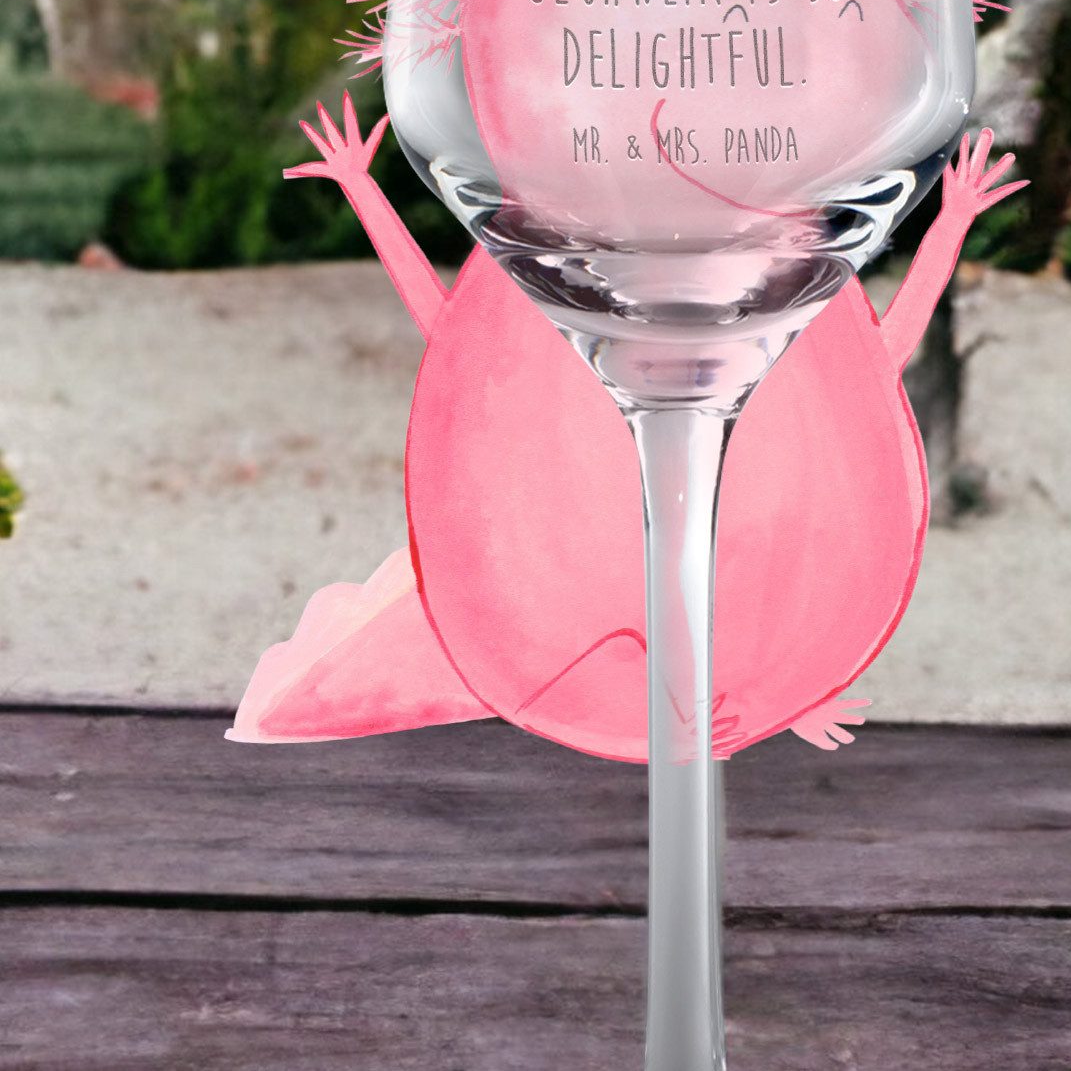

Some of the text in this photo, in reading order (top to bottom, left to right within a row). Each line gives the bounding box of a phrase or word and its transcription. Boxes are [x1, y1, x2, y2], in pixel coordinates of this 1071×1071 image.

[562, 26, 807, 89] DELIGHTFUL.
[573, 127, 799, 165] MR. & MRS. PANDA
